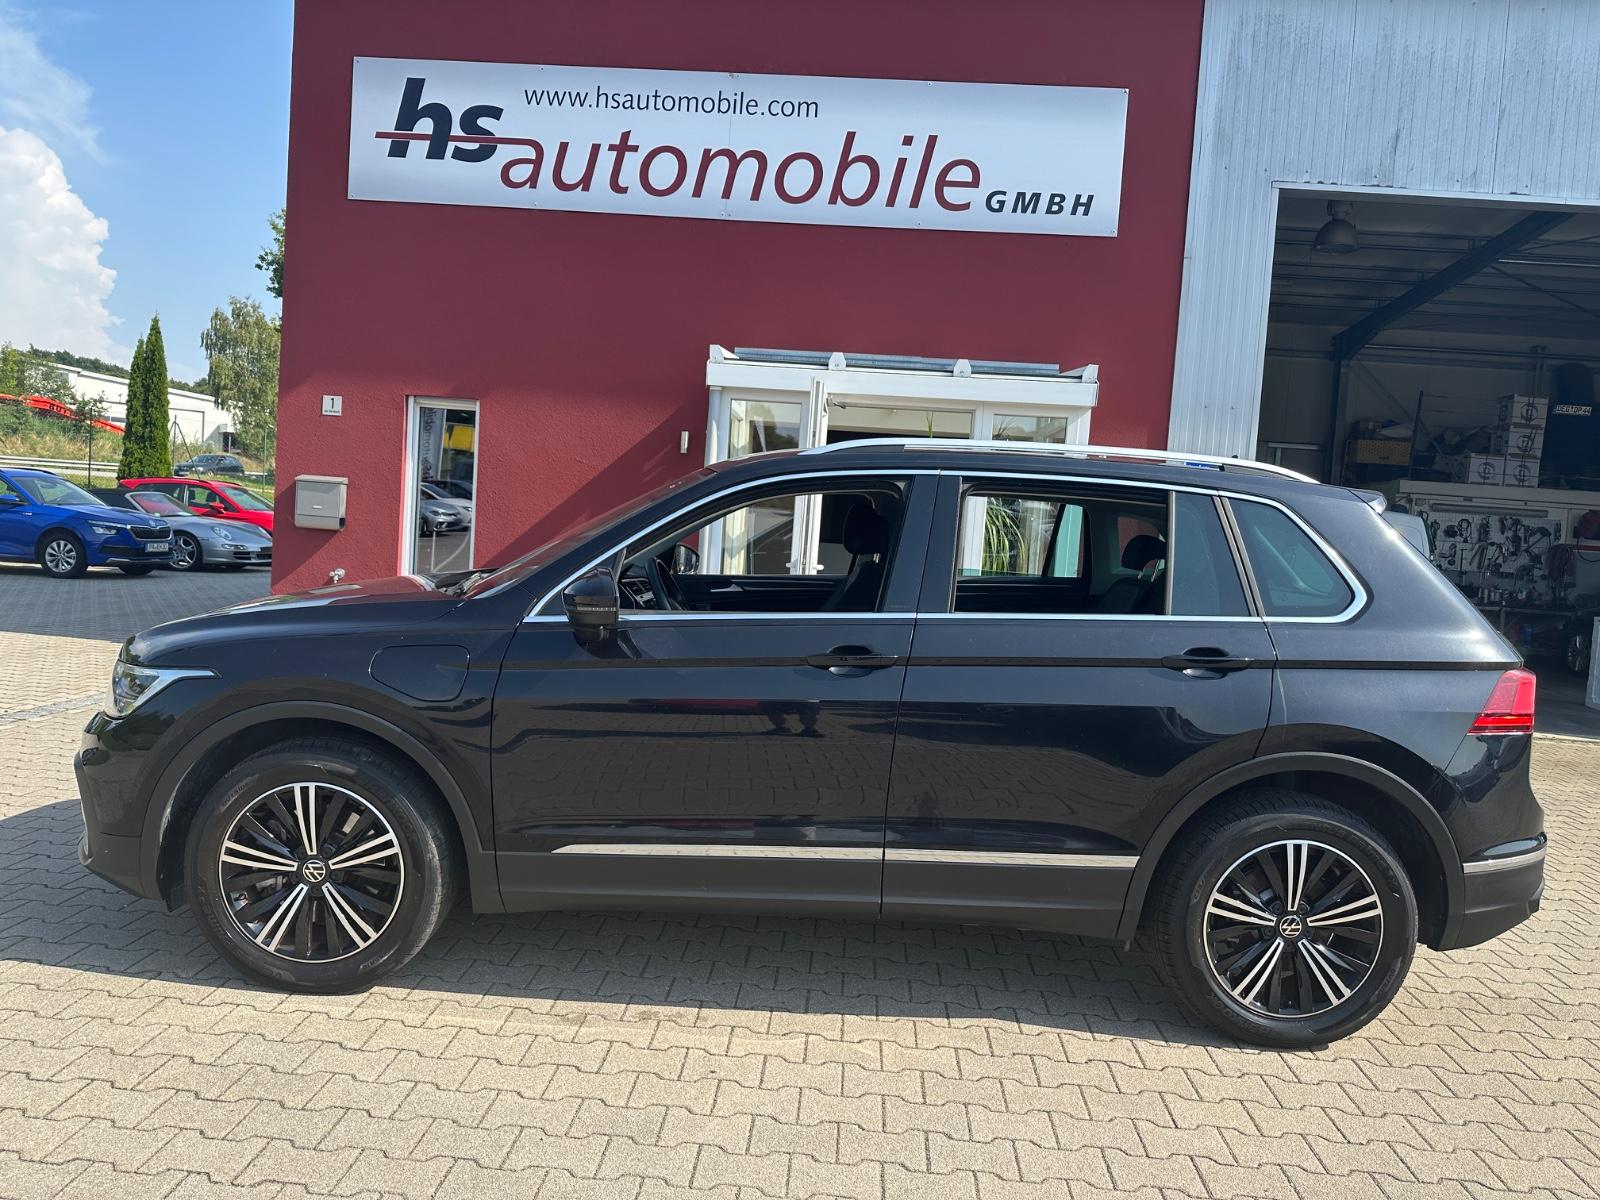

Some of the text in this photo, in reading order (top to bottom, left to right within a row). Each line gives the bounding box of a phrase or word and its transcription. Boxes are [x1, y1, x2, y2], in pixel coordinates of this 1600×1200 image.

[524, 86, 819, 118] www.hsautomobile.com
[387, 77, 504, 163] hs
[985, 190, 1094, 216] GMBH
[330, 397, 335, 409] 1
